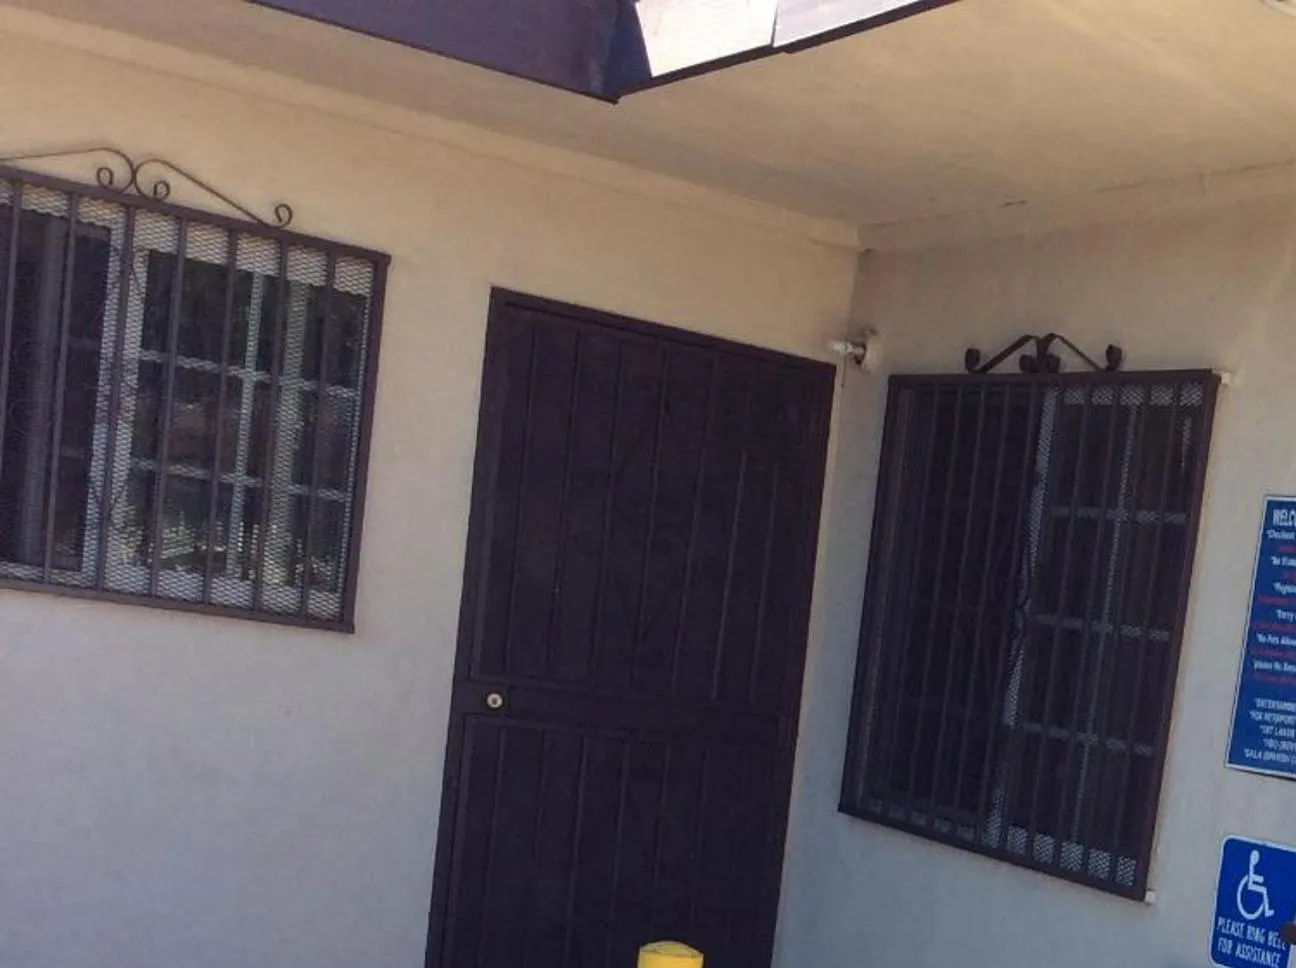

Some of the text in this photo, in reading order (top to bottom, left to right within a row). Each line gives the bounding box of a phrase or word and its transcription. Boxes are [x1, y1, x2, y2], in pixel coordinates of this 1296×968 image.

[1217, 916, 1245, 939] PLEASE
[1247, 924, 1266, 945] RING
[1218, 937, 1281, 968] FOR ASSISTANCE
